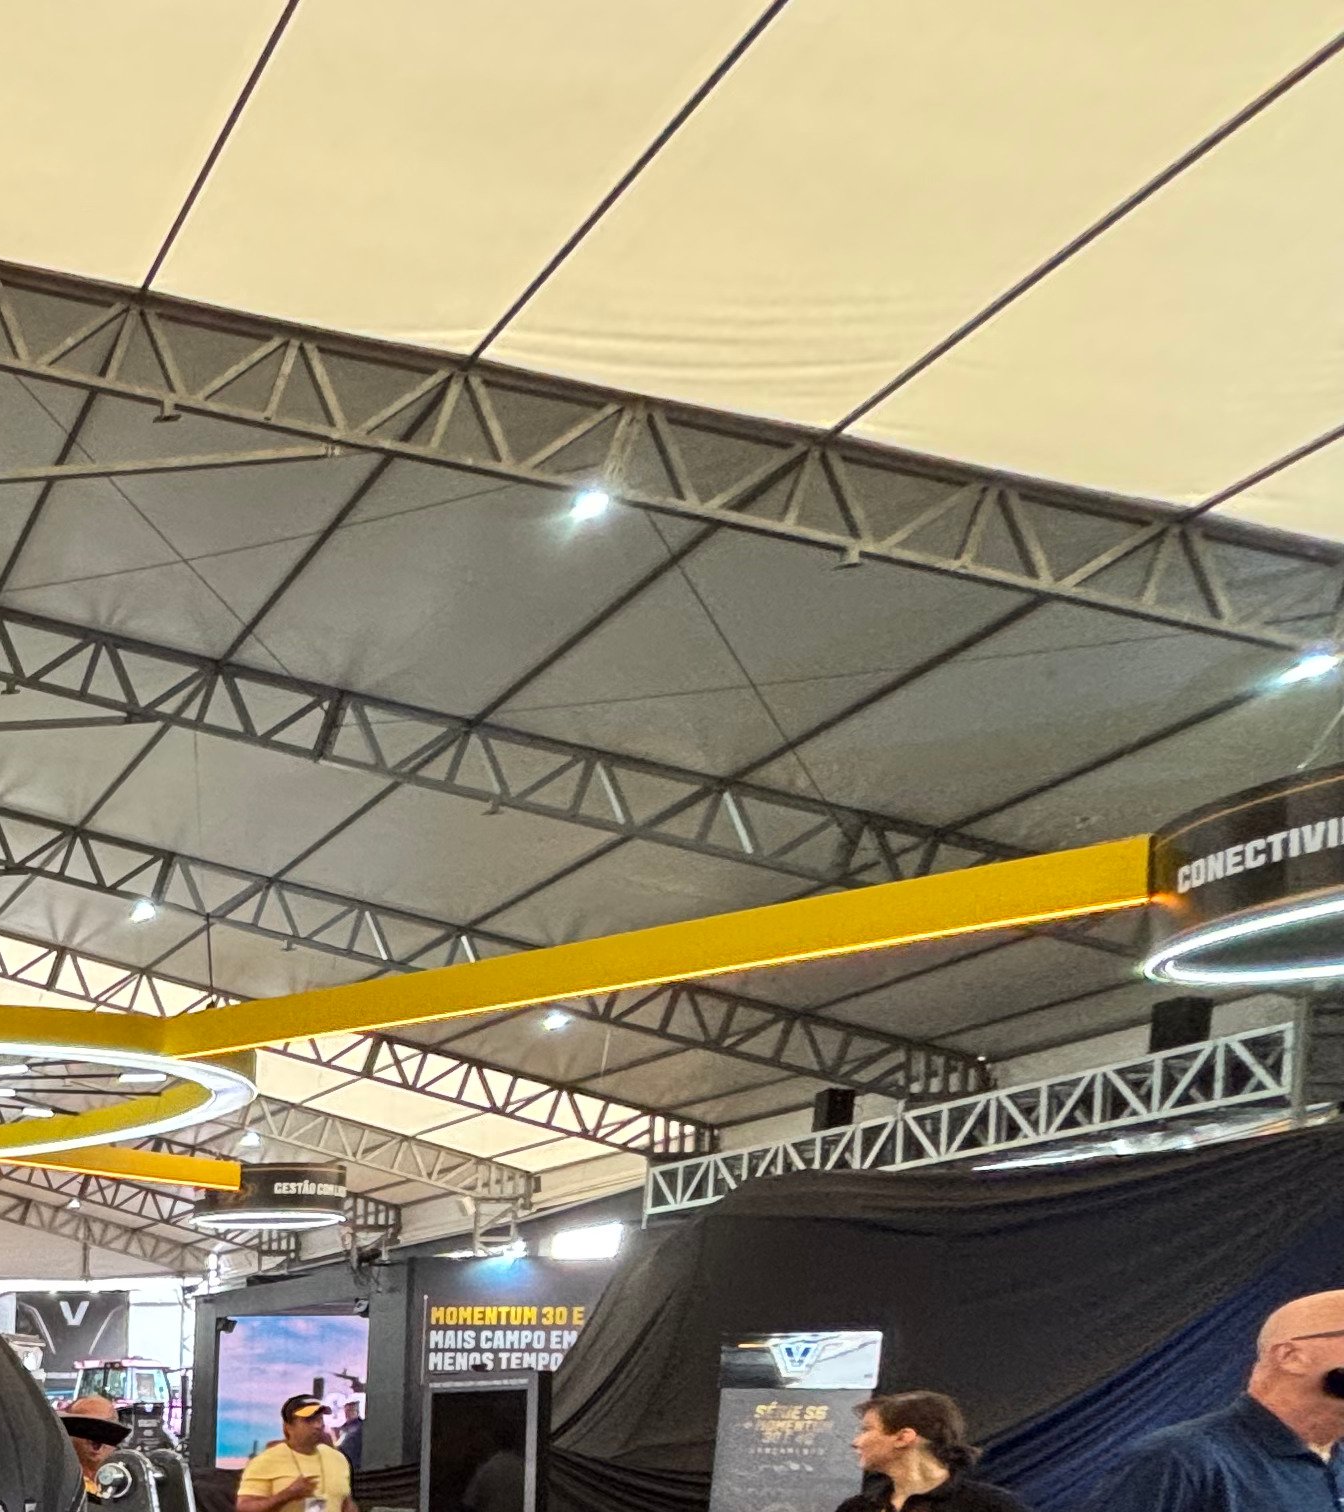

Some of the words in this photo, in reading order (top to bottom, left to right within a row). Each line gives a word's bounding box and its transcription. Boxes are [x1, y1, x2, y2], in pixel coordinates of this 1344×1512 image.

[1177, 816, 1344, 894] CONECTIVI
[273, 1179, 317, 1195] GESTÃO
[430, 1305, 538, 1326] MOMENTUM
[541, 1306, 569, 1326] 30
[572, 1306, 586, 1326] E
[429, 1329, 477, 1350] MAIS
[480, 1330, 546, 1350] CAMPO
[549, 1330, 579, 1350] EM
[428, 1352, 495, 1372] MENOS
[498, 1352, 564, 1372] TEMPO
